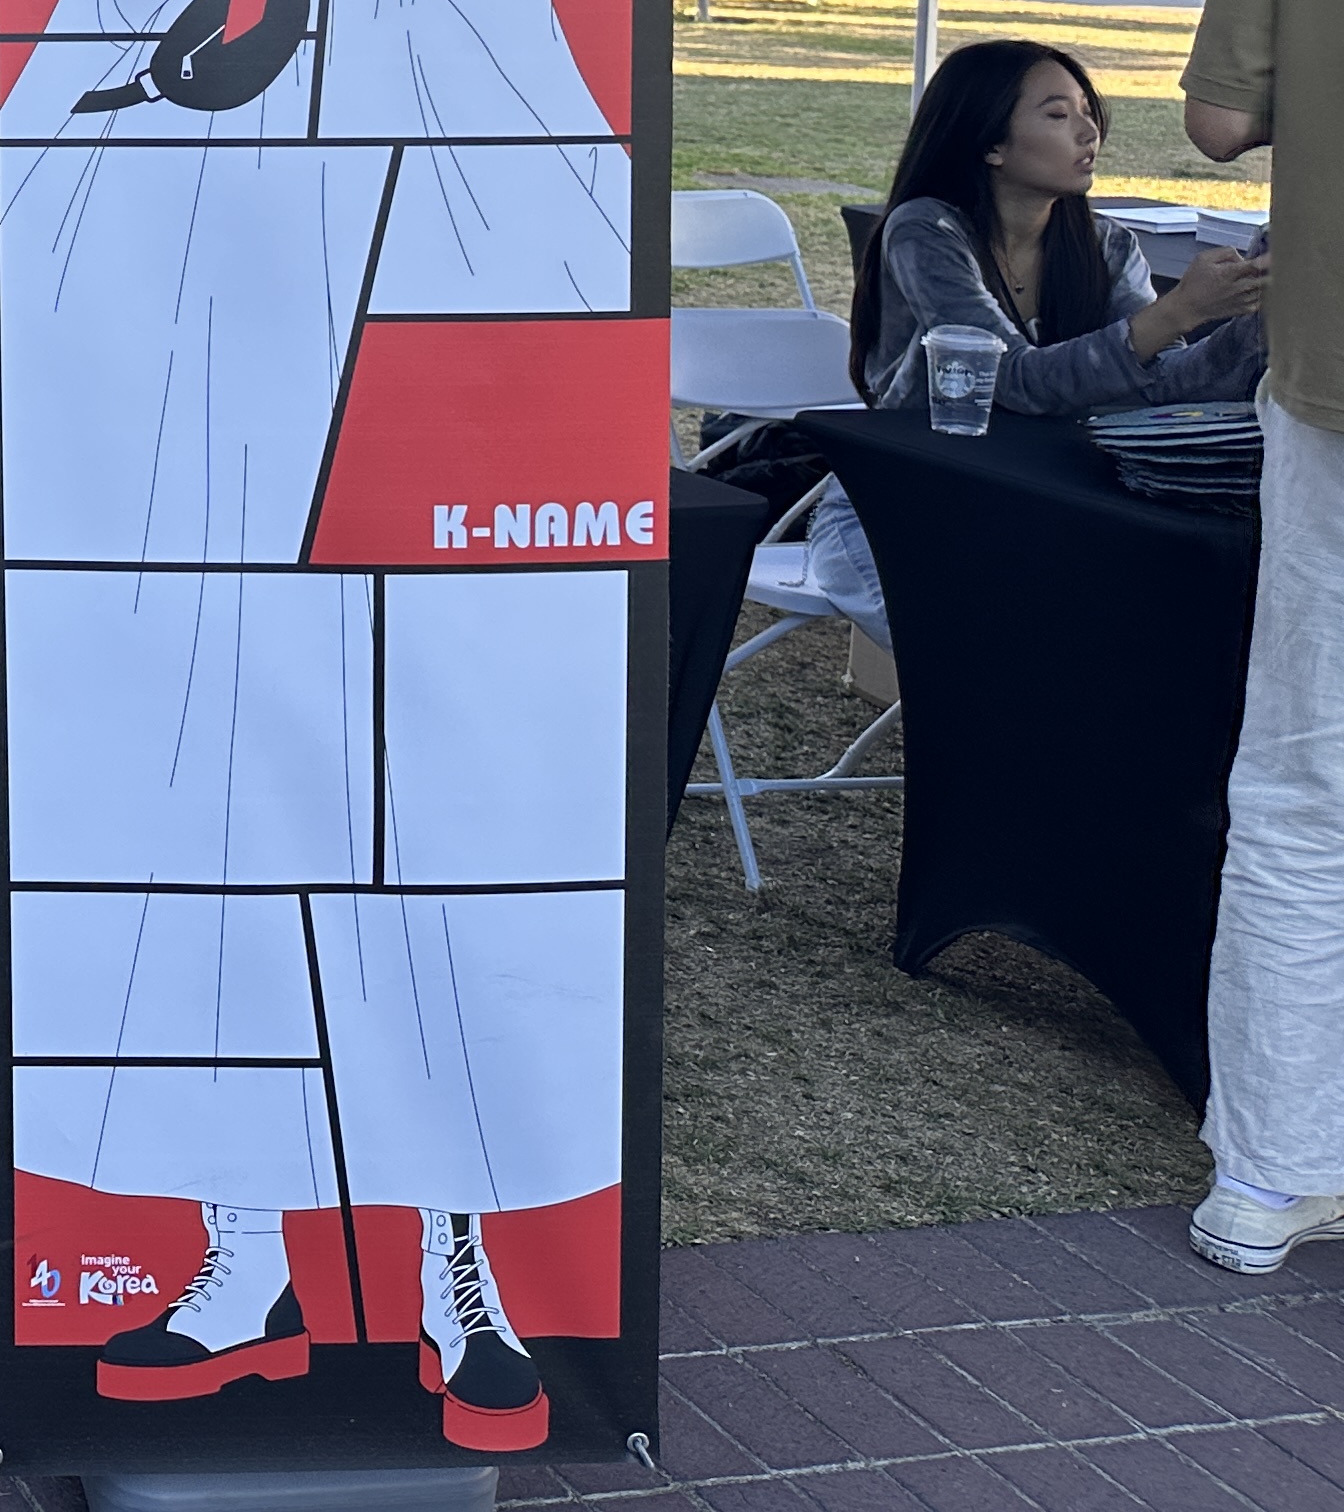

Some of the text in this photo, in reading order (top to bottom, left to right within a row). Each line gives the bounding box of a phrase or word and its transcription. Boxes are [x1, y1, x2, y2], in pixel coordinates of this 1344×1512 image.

[433, 501, 654, 549] K-NAME
[81, 1254, 130, 1268] Imagine
[112, 1265, 142, 1277] your
[79, 1270, 159, 1305] Korea
